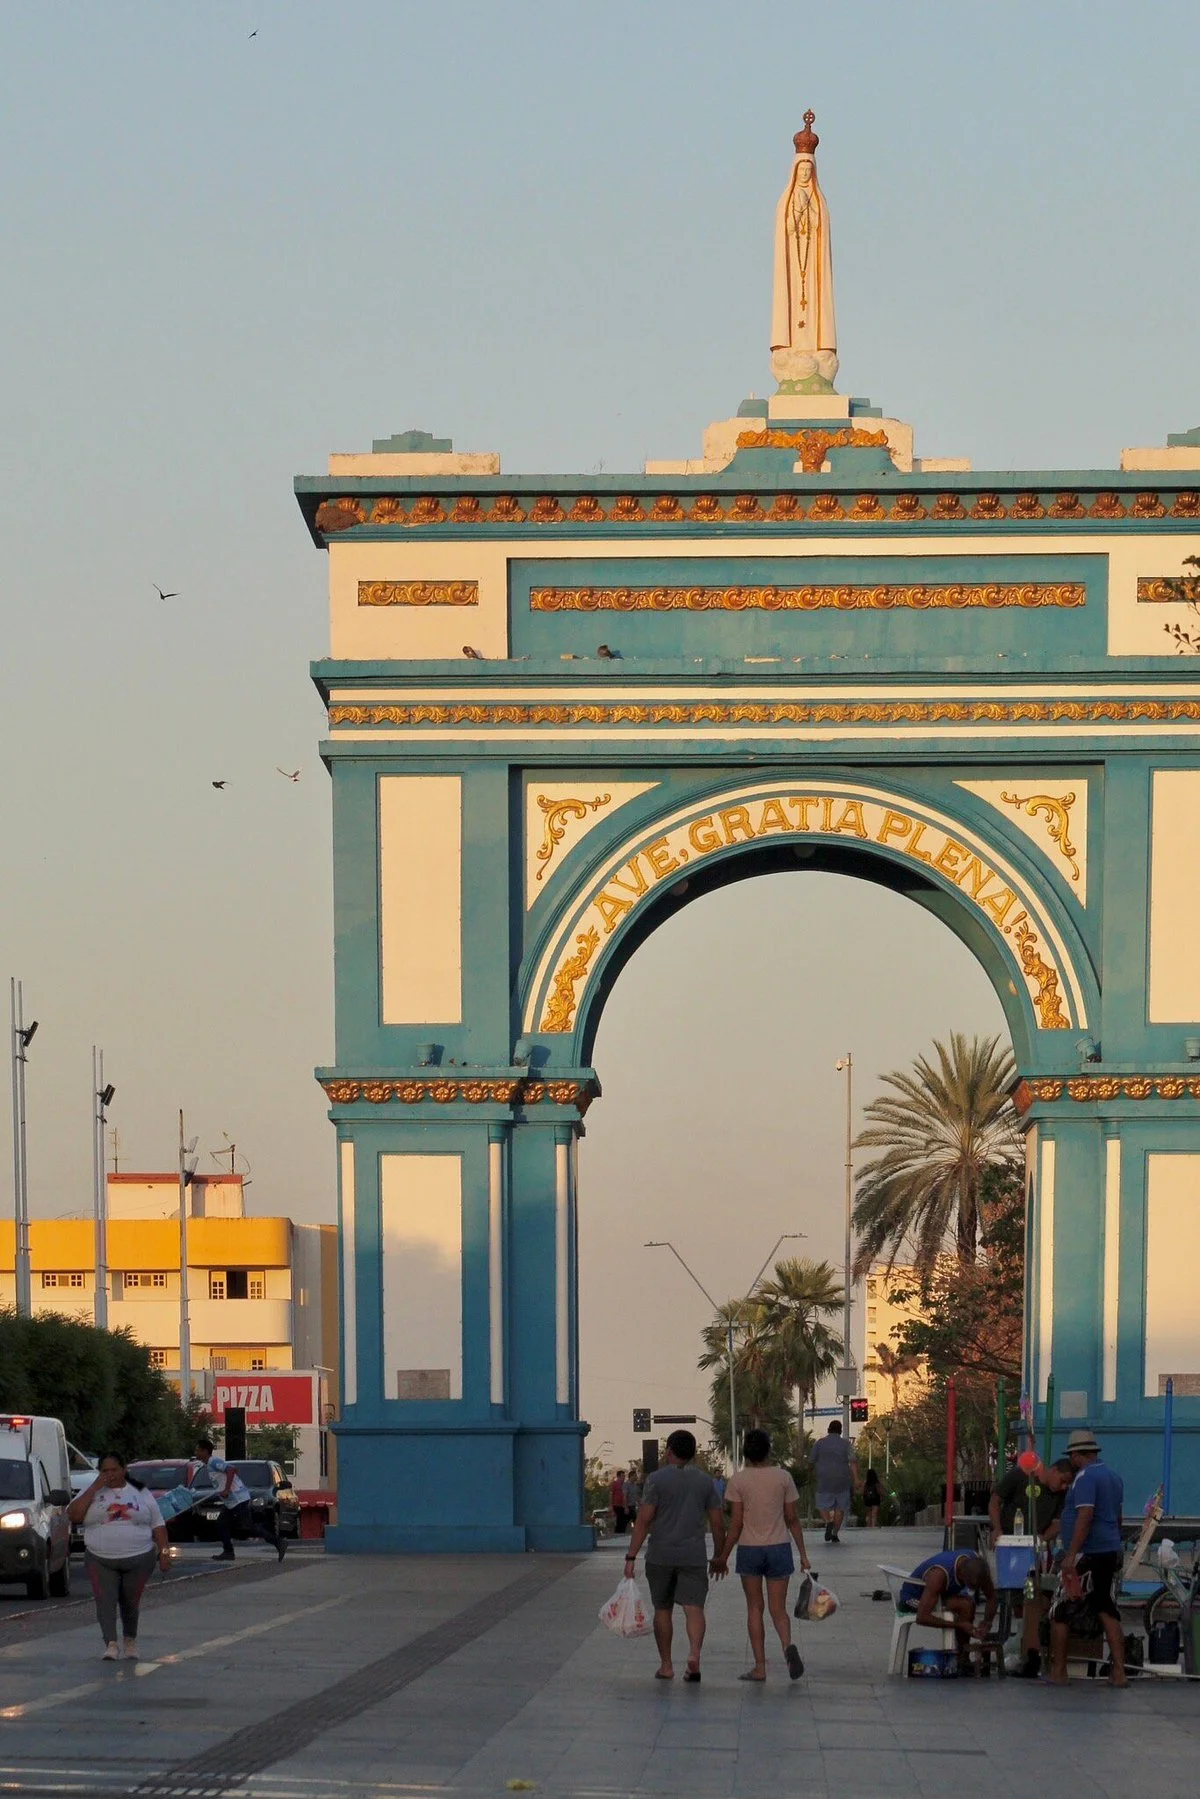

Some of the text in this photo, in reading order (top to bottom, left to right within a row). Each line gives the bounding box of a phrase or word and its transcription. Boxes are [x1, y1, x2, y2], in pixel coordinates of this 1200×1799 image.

[593, 797, 1028, 934] AVE, GRATIA PLENA!
[216, 1385, 275, 1412] PIZZA
